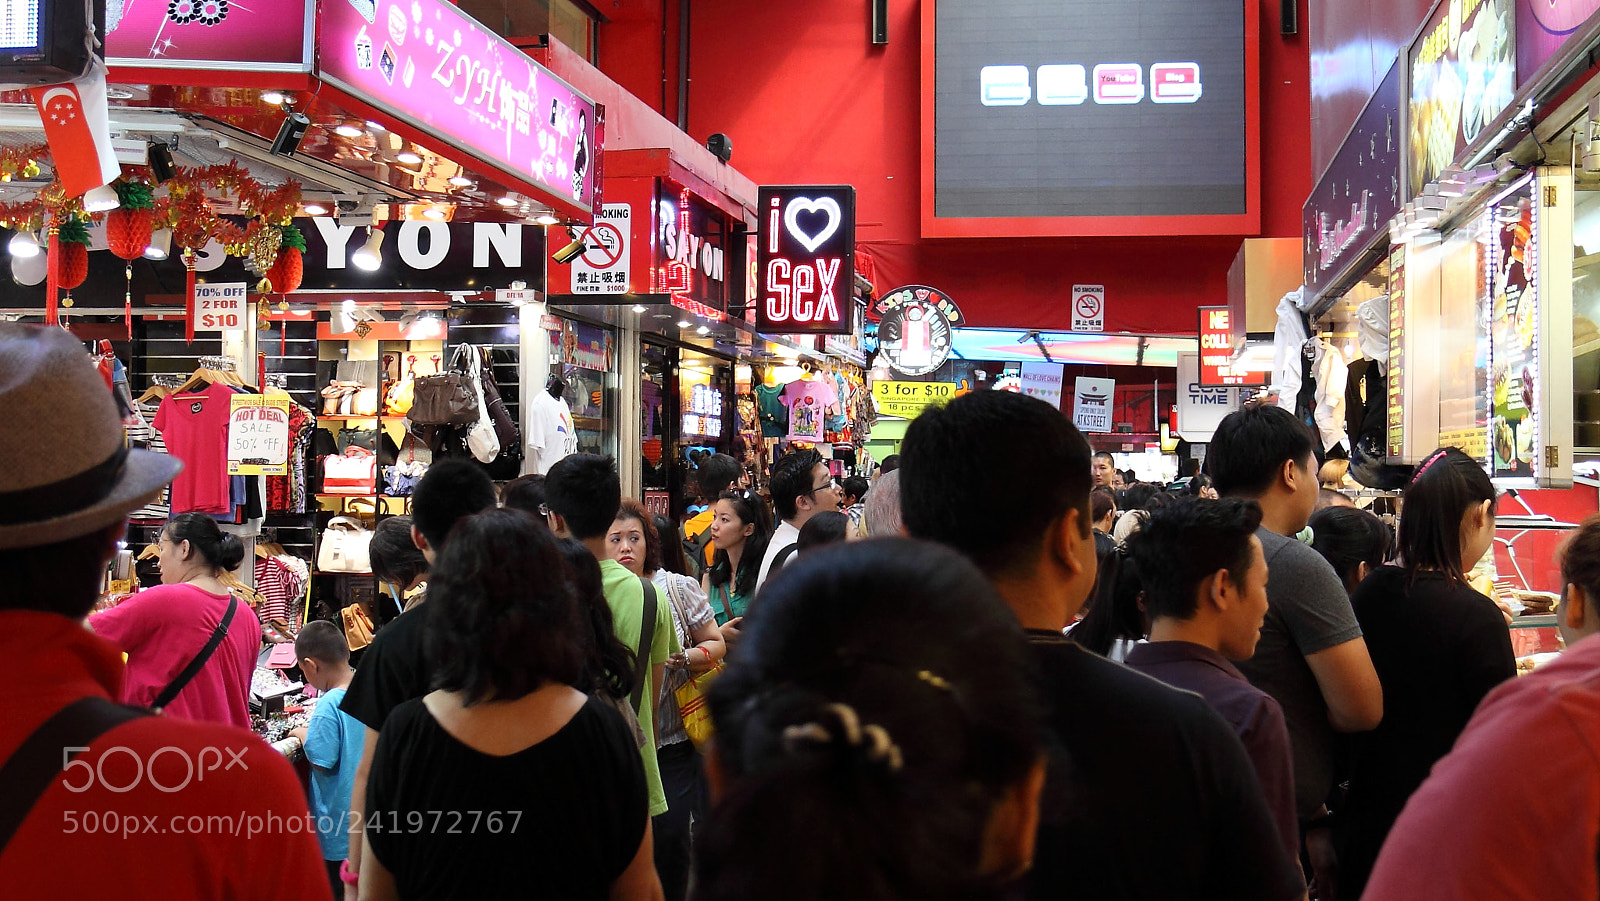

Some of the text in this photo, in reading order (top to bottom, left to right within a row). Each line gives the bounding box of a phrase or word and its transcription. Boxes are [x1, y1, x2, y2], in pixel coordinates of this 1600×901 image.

[432, 40, 501, 113] ZYH
[577, 272, 626, 283] 禁止吸烟
[196, 287, 244, 297] 70% OFF
[202, 301, 238, 309] 2 FOR
[202, 314, 238, 328] $10
[881, 384, 949, 397] 3 for $10
[1189, 395, 1228, 404] TIME
[236, 410, 284, 423] HOT DEAL
[240, 423, 272, 433] SALE
[234, 438, 257, 453] 50%
